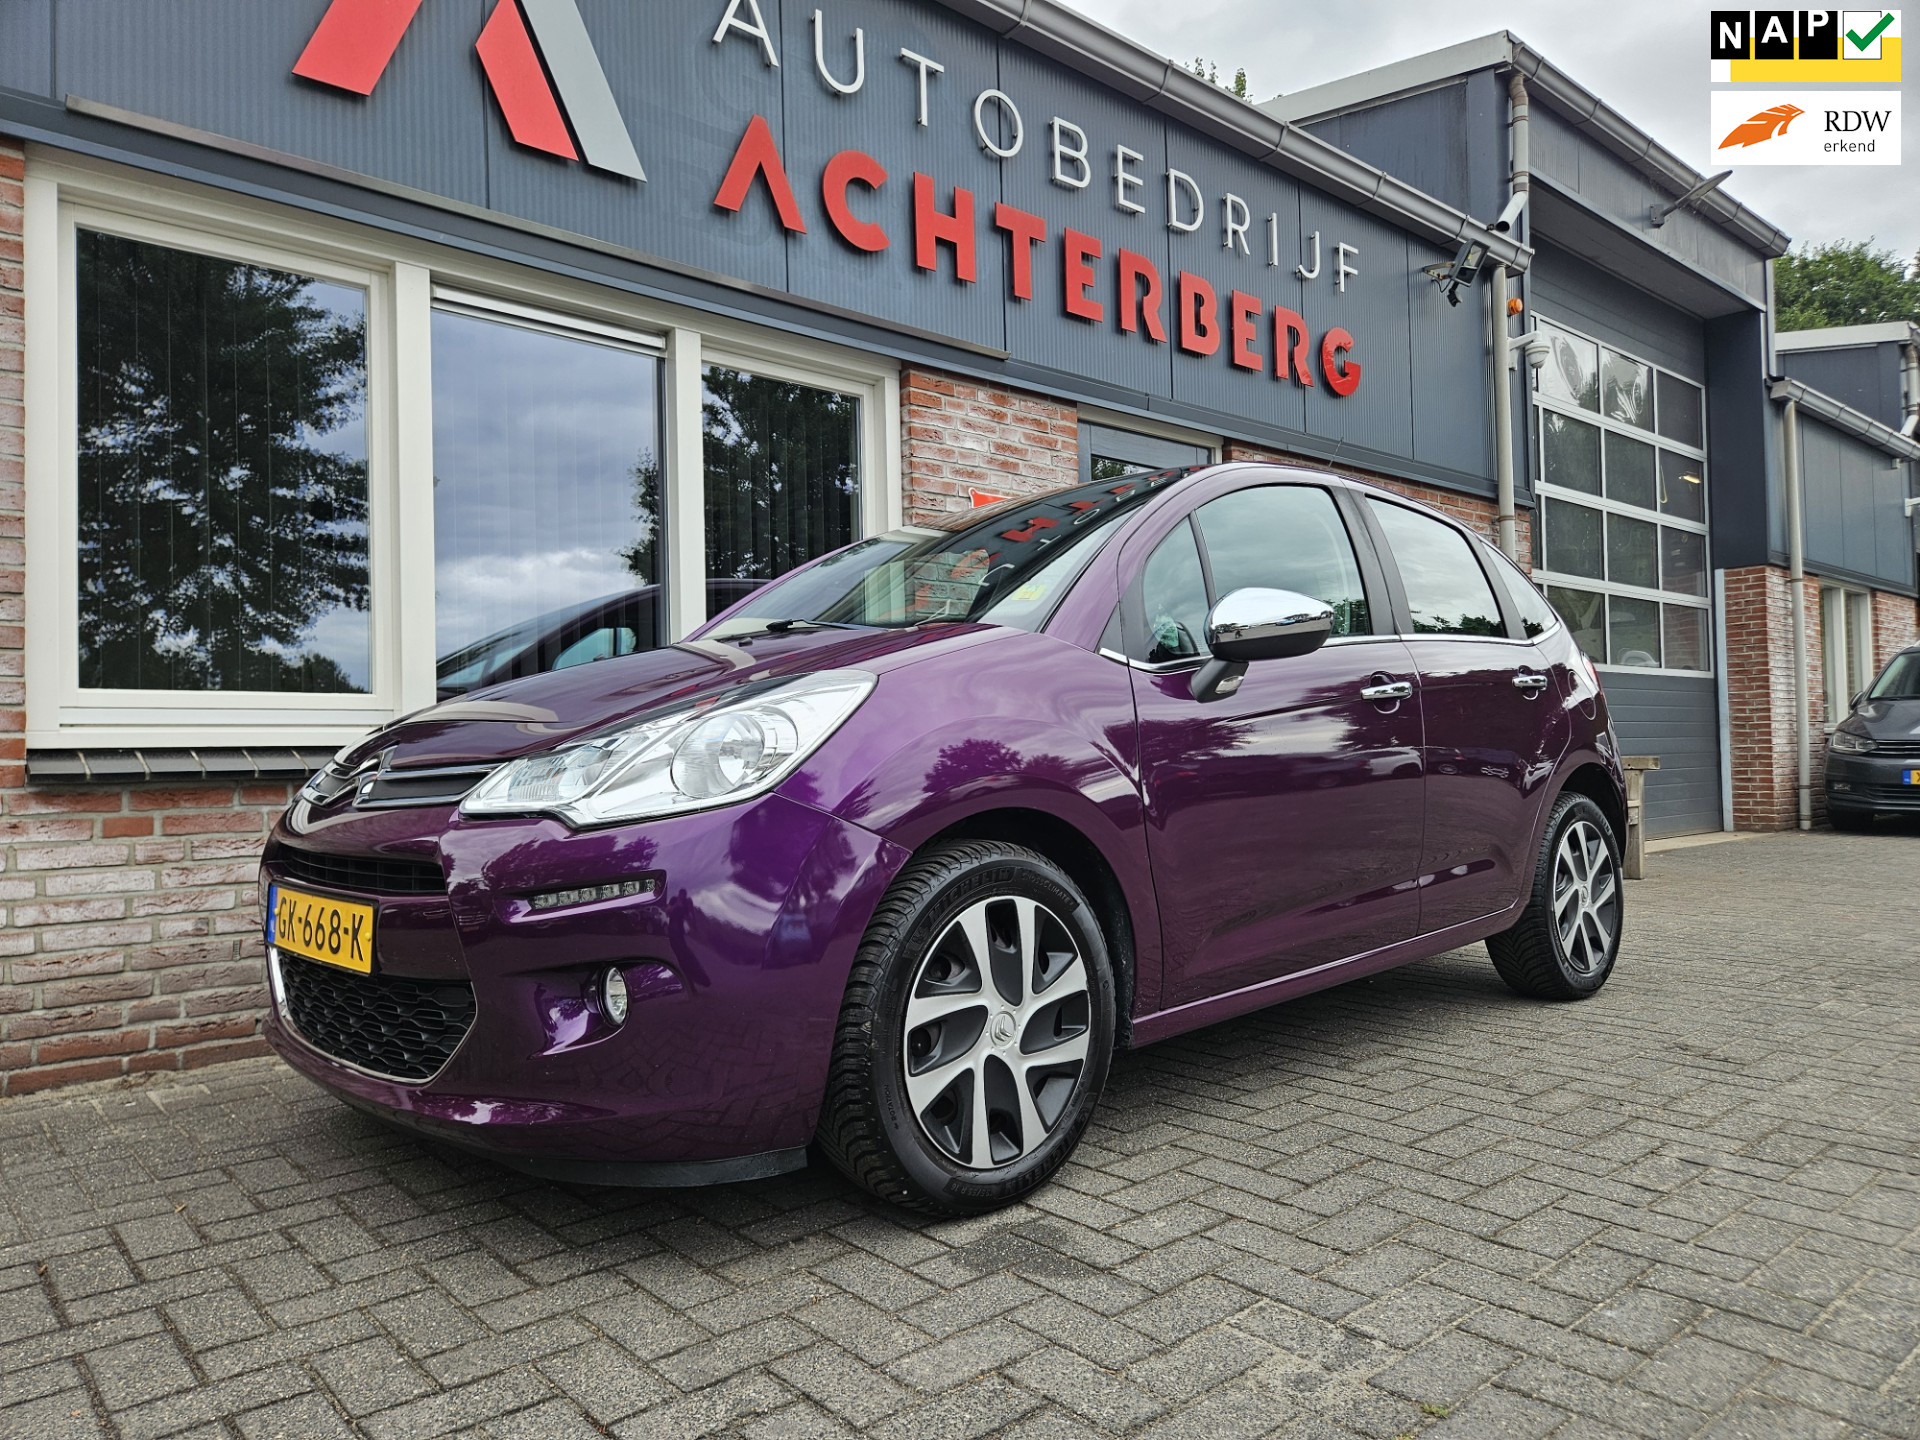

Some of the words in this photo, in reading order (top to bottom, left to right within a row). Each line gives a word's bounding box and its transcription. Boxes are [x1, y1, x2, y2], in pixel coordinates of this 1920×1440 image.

[712, 0, 1359, 292] AUTOBEDRIJF
[713, 114, 1362, 397] ACHTERBERG
[278, 896, 364, 962] GK-668-K
